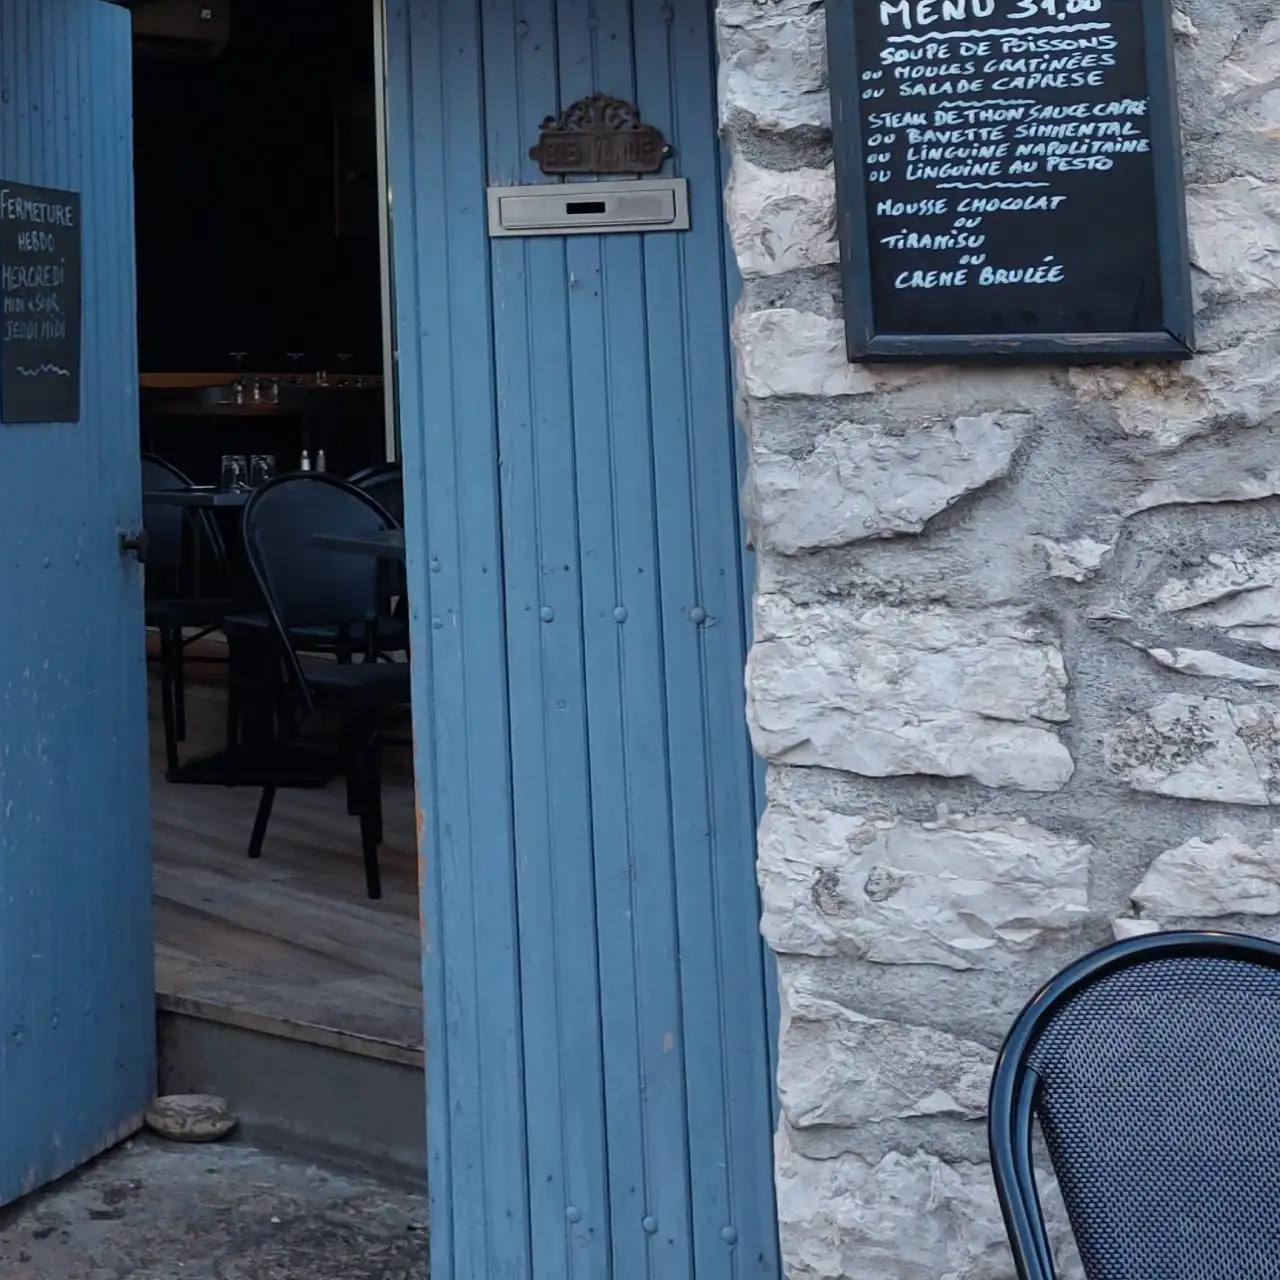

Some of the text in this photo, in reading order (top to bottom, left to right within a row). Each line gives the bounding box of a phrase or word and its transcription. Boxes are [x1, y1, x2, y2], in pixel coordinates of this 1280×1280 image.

[879, 43, 952, 65] SOUPE
[959, 41, 992, 56] DE
[894, 61, 976, 80] MOULES
[899, 70, 1105, 97] SALADE CAPRESE
[868, 102, 1091, 129] STEAK DE THON SAUCE
[906, 124, 1009, 145] BAVETTE
[1008, 159, 1039, 175] AU
[1046, 155, 1114, 172] PESTO
[0, 188, 75, 227] FERMETURE
[876, 195, 1068, 216] MOUSSE CHOCOLAT
[894, 268, 969, 289] CREME
